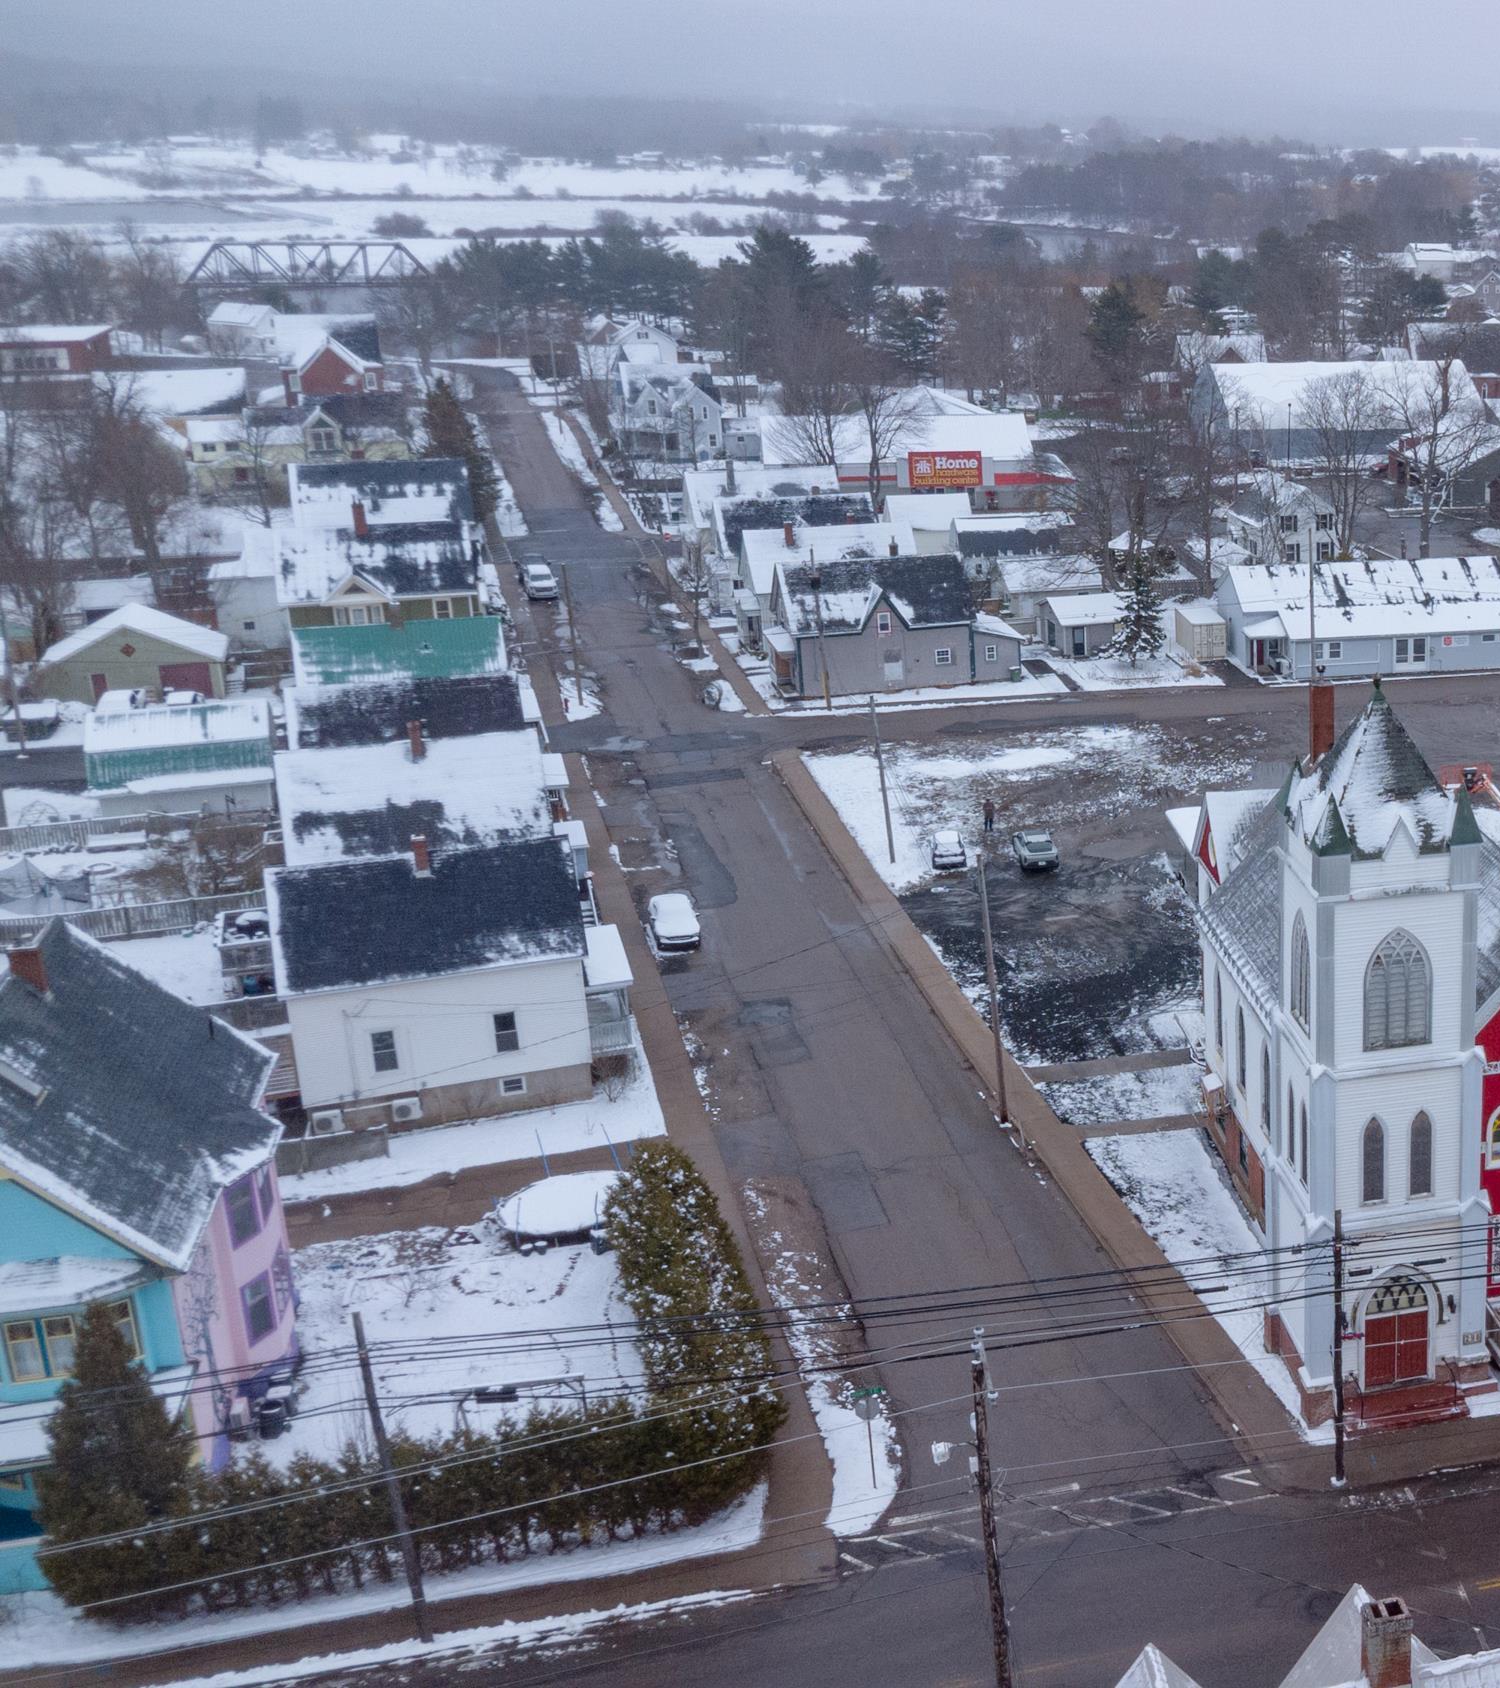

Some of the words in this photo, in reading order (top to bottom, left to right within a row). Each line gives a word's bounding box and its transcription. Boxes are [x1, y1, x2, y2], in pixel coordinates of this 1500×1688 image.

[934, 456, 978, 469] Home
[913, 476, 951, 486] building
[951, 476, 979, 485] centre
